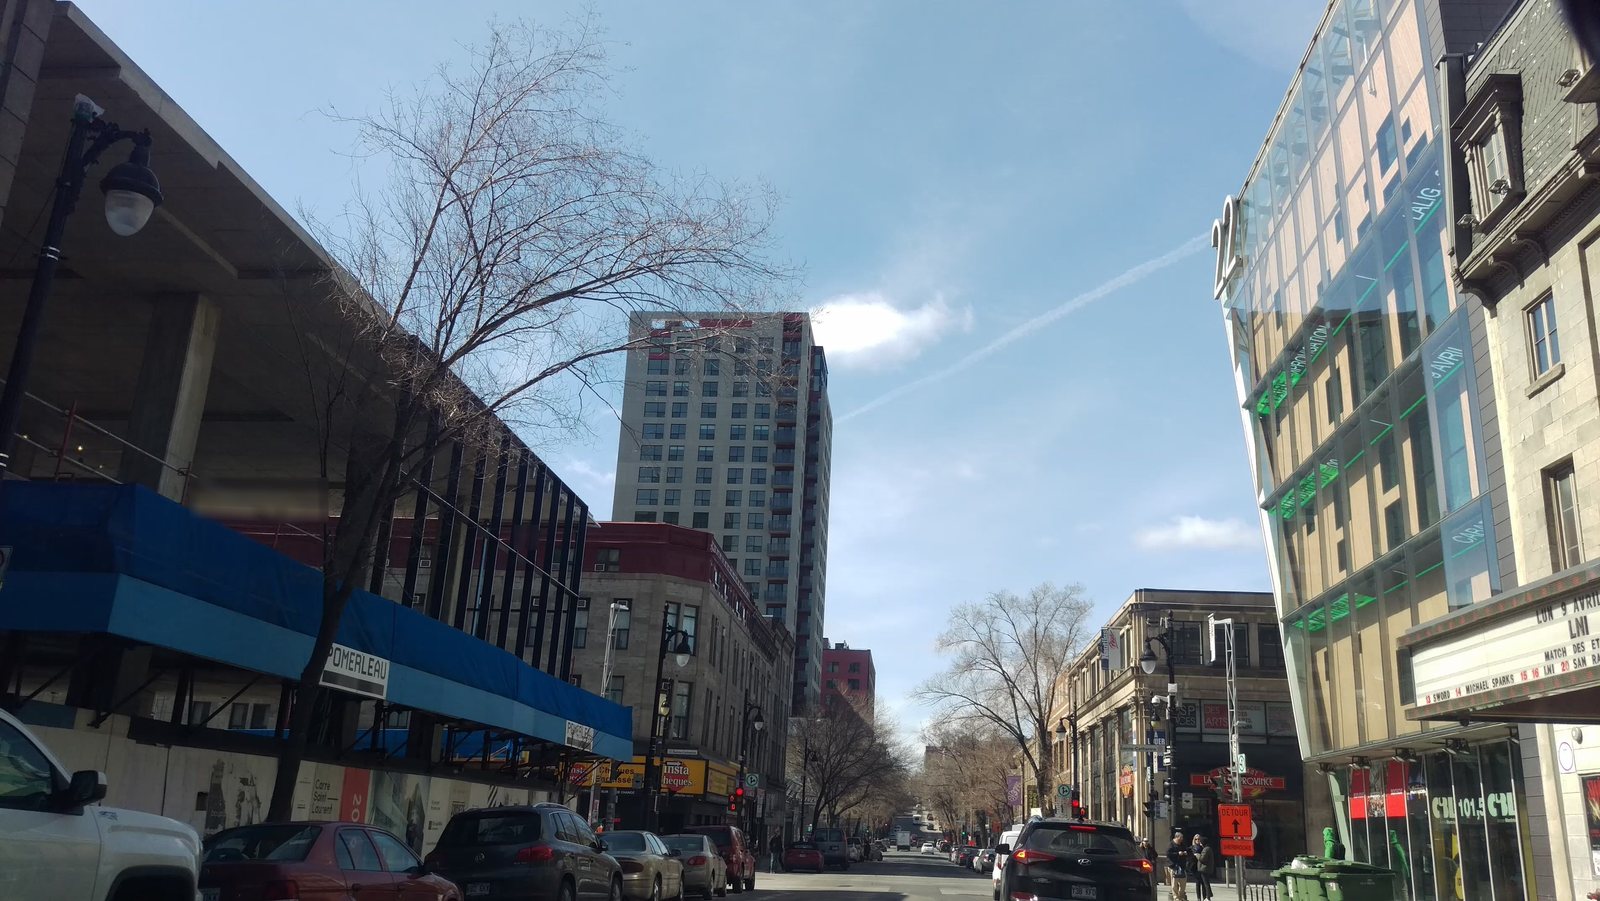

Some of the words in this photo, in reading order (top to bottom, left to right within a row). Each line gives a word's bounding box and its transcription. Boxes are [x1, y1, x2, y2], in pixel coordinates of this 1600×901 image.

[1535, 604, 1554, 624] LUN
[1561, 600, 1568, 617] 9
[1573, 590, 1600, 613] AVRIL
[1567, 615, 1590, 640] LNI
[1544, 646, 1568, 662] MATCH
[1572, 641, 1586, 655] DES
[1426, 694, 1432, 705] 13
[1433, 690, 1451, 703] SWORD
[1455, 687, 1462, 697] 14
[1465, 680, 1490, 694] MICHAEL
[1491, 674, 1516, 688] SPARKS
[1520, 670, 1529, 682] 15
[1531, 667, 1540, 679] 16
[1561, 659, 1570, 672] 20
[1572, 656, 1588, 669] SAN
[1146, 737, 1166, 746] LUER
[1240, 777, 1273, 787] ROVINCE
